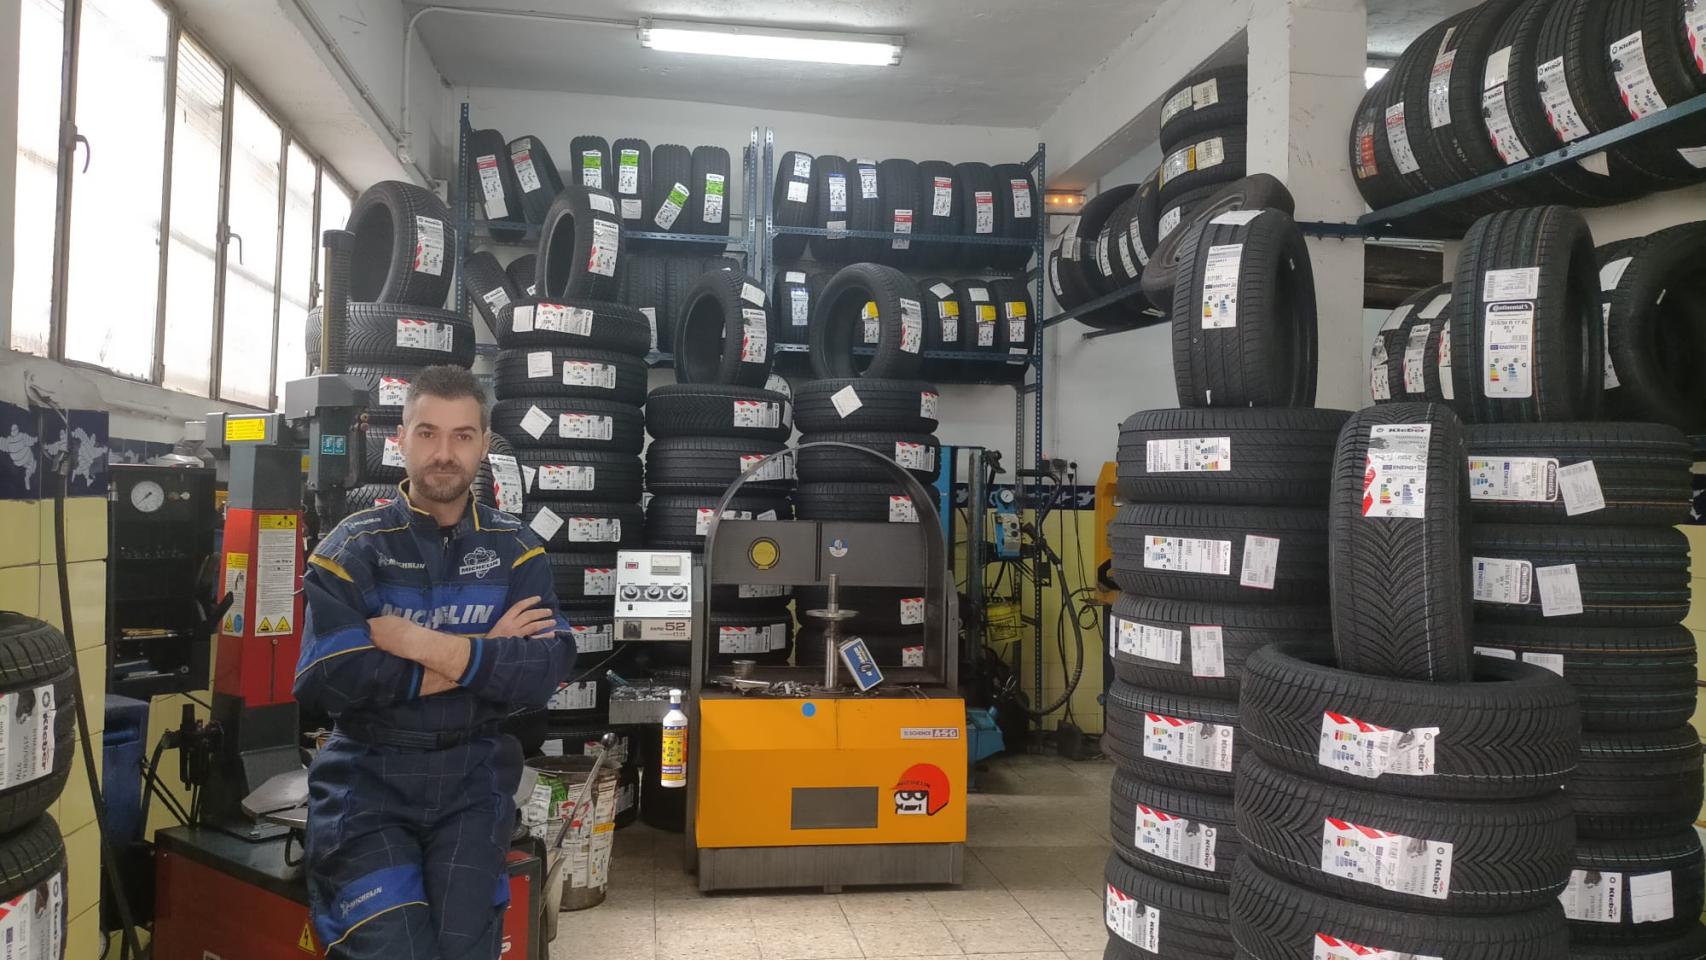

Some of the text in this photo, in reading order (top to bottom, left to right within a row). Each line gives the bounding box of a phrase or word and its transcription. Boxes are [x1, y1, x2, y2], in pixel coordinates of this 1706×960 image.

[389, 558, 426, 569] MICHELIN
[461, 559, 499, 573] MICHELIN
[665, 621, 686, 631] 52
[1432, 859, 1443, 895] Kleber
